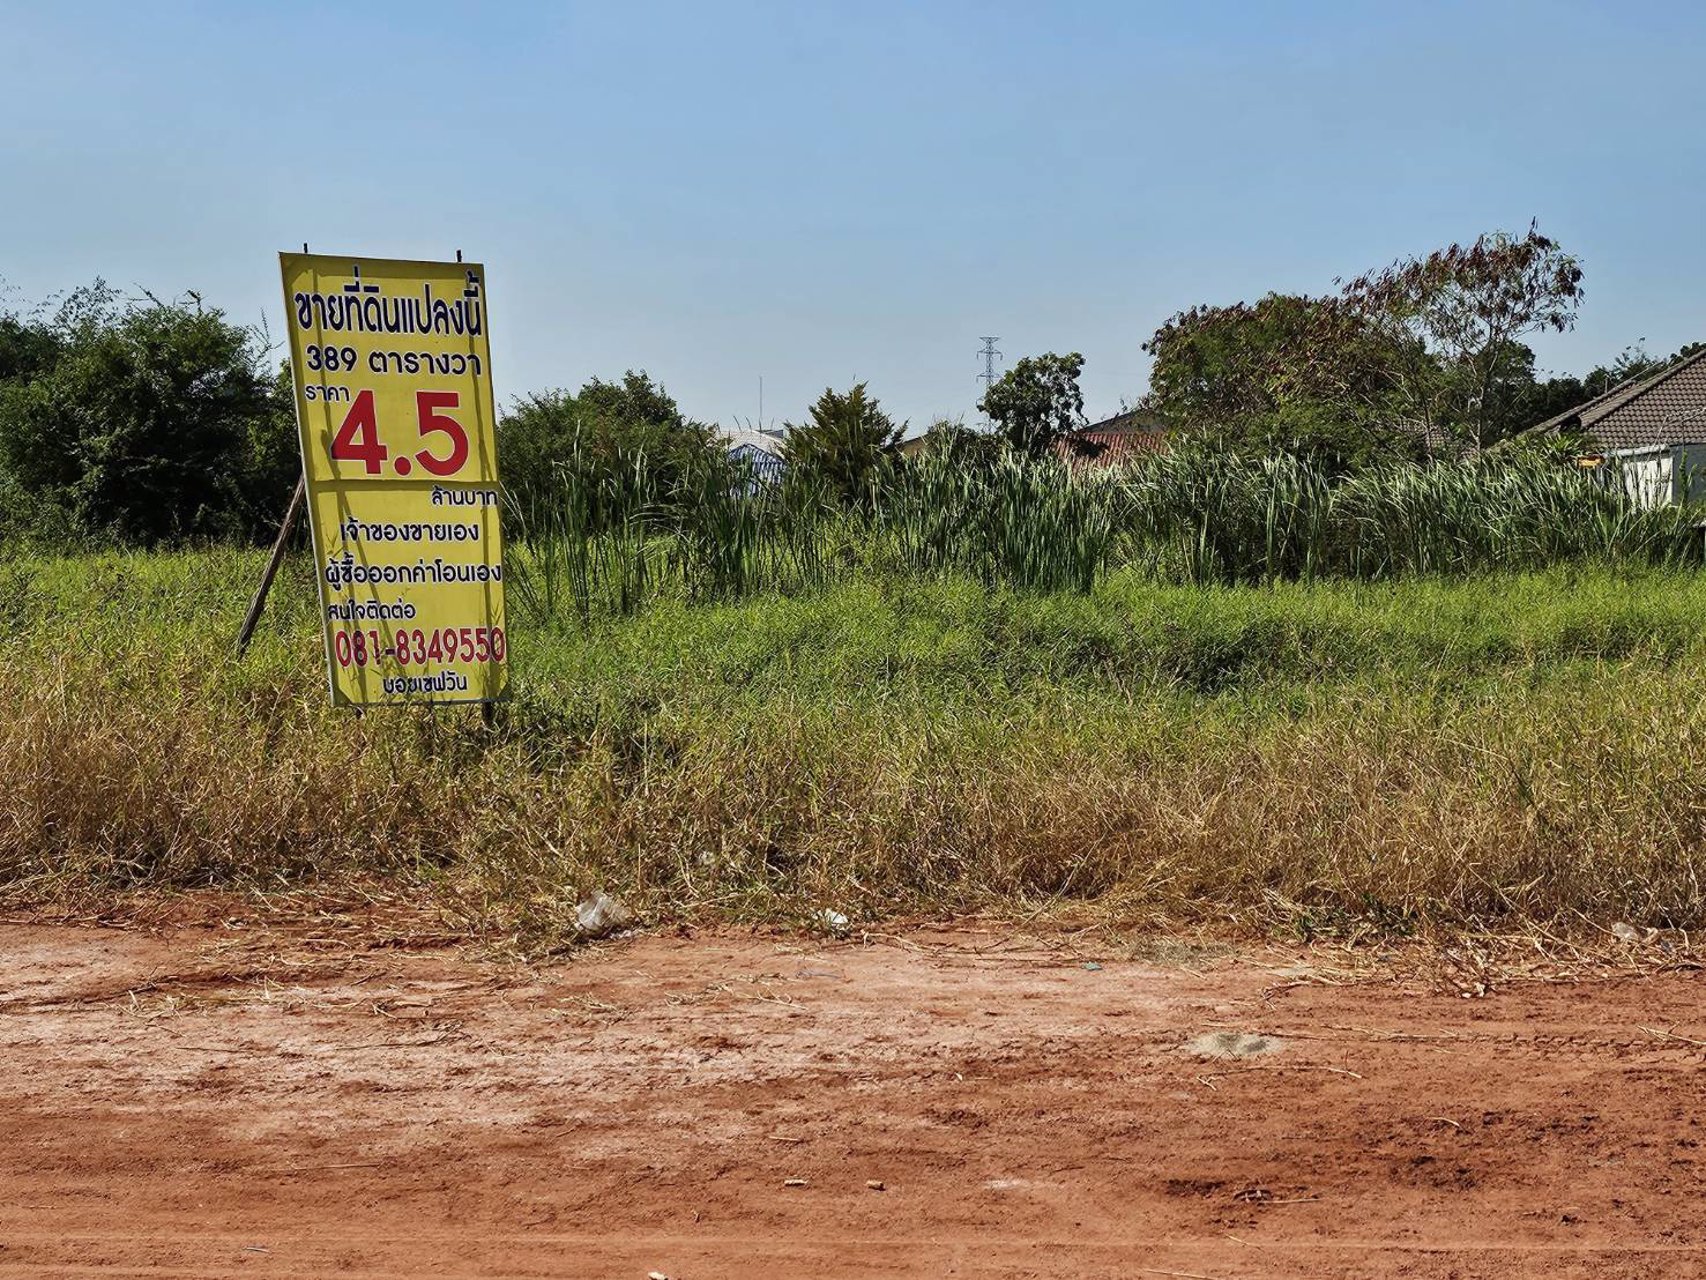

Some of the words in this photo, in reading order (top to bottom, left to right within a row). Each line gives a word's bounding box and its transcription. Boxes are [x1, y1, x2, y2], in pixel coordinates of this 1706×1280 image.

[295, 265, 482, 336] ขายที่ดินแปลงนี้
[307, 344, 358, 372] 389
[368, 349, 482, 376] ตารางวา
[305, 384, 350, 402] ราคา
[330, 389, 469, 477] 4.5
[431, 485, 498, 506] ล้านบาท
[340, 516, 479, 542] เจ้าของขายเอง
[325, 552, 502, 591] ผู้ซื้อออกค่าโอนเอง
[328, 597, 416, 620] สนใจติดต่อ
[335, 626, 507, 668] 081-8349550
